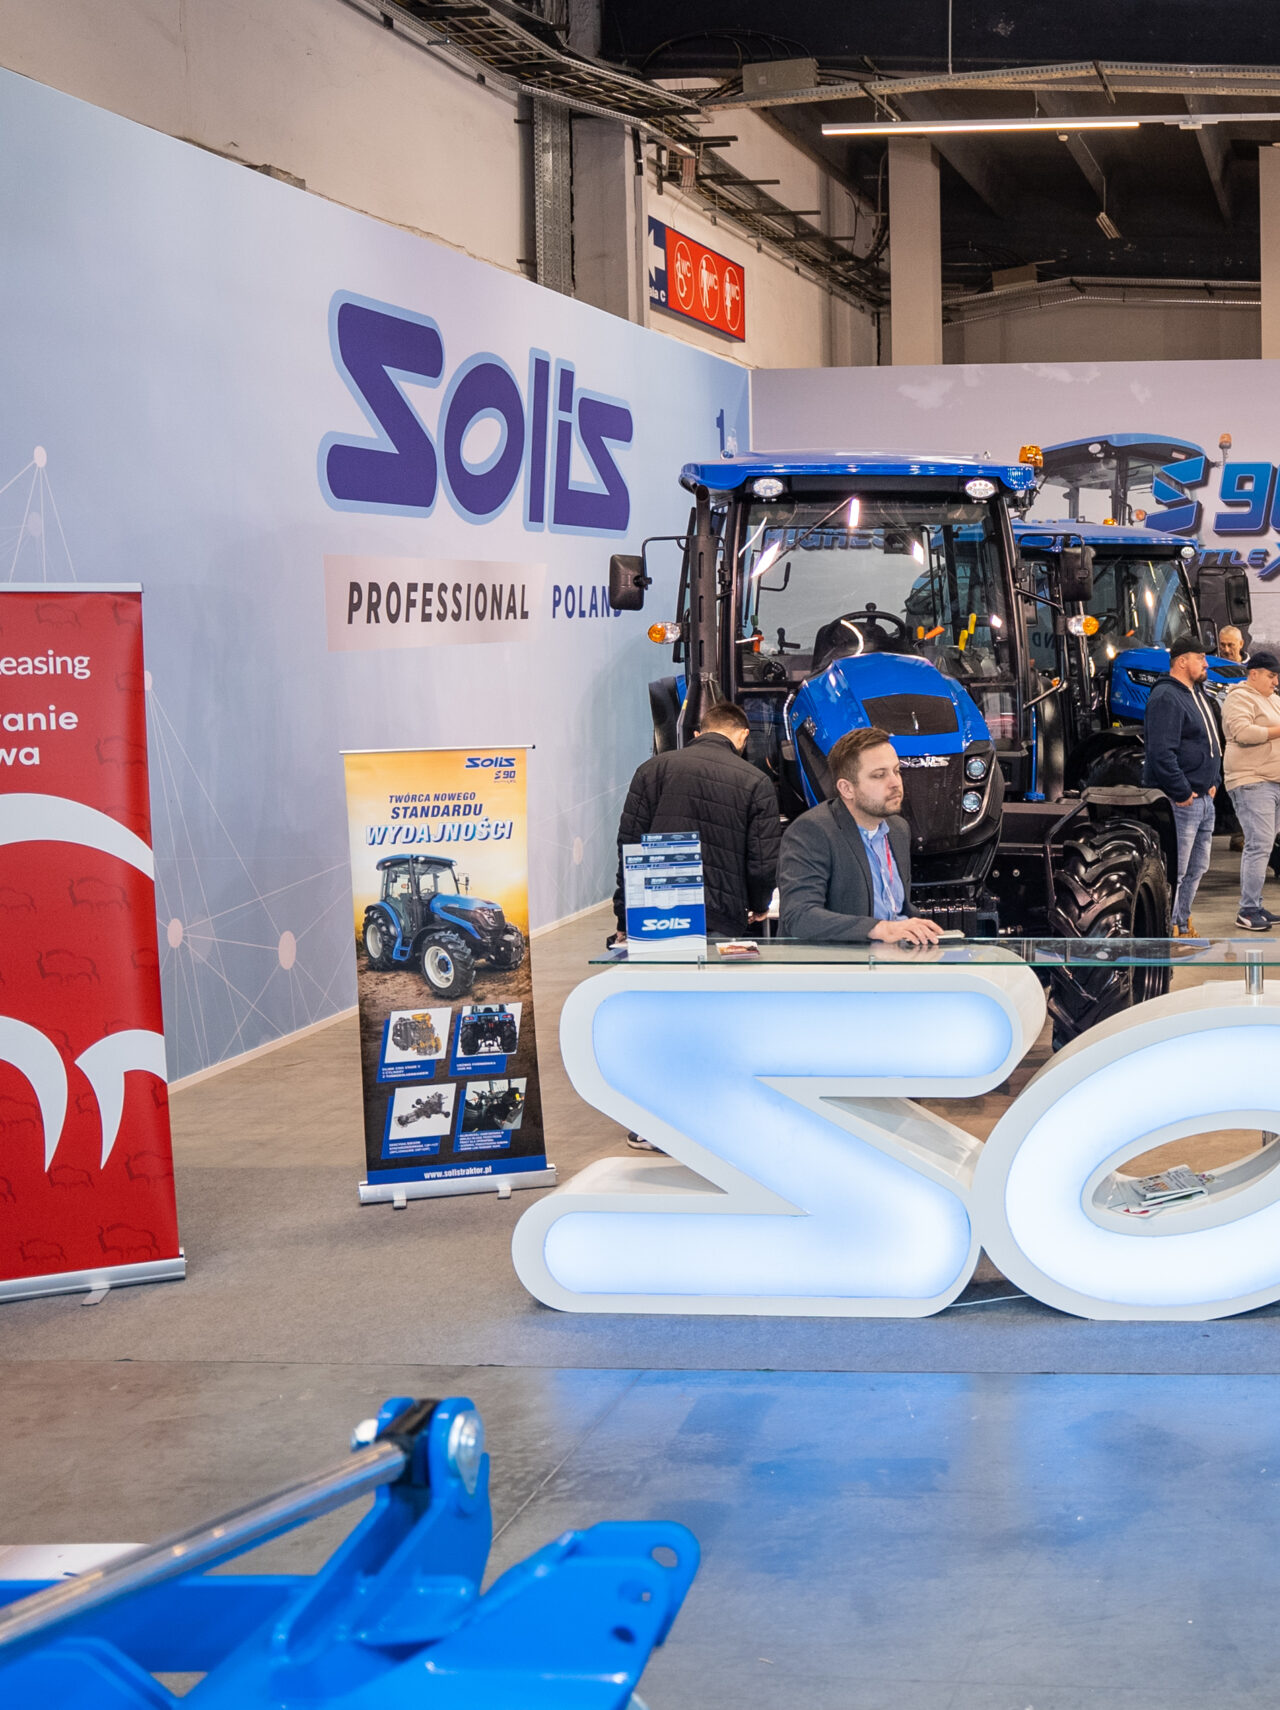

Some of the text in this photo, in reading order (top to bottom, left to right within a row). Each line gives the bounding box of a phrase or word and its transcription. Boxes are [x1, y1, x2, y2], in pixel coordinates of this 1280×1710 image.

[347, 581, 622, 624] PROFESSIONAL POLAN
[0, 649, 91, 680] easing
[0, 704, 78, 732] anie
[389, 792, 476, 804] TWÓRCA NOWEGO
[391, 803, 483, 819] STANDARDU
[365, 816, 513, 846] WYDAJNOŚCI
[424, 1165, 492, 1180] www.solistraktor.pl
